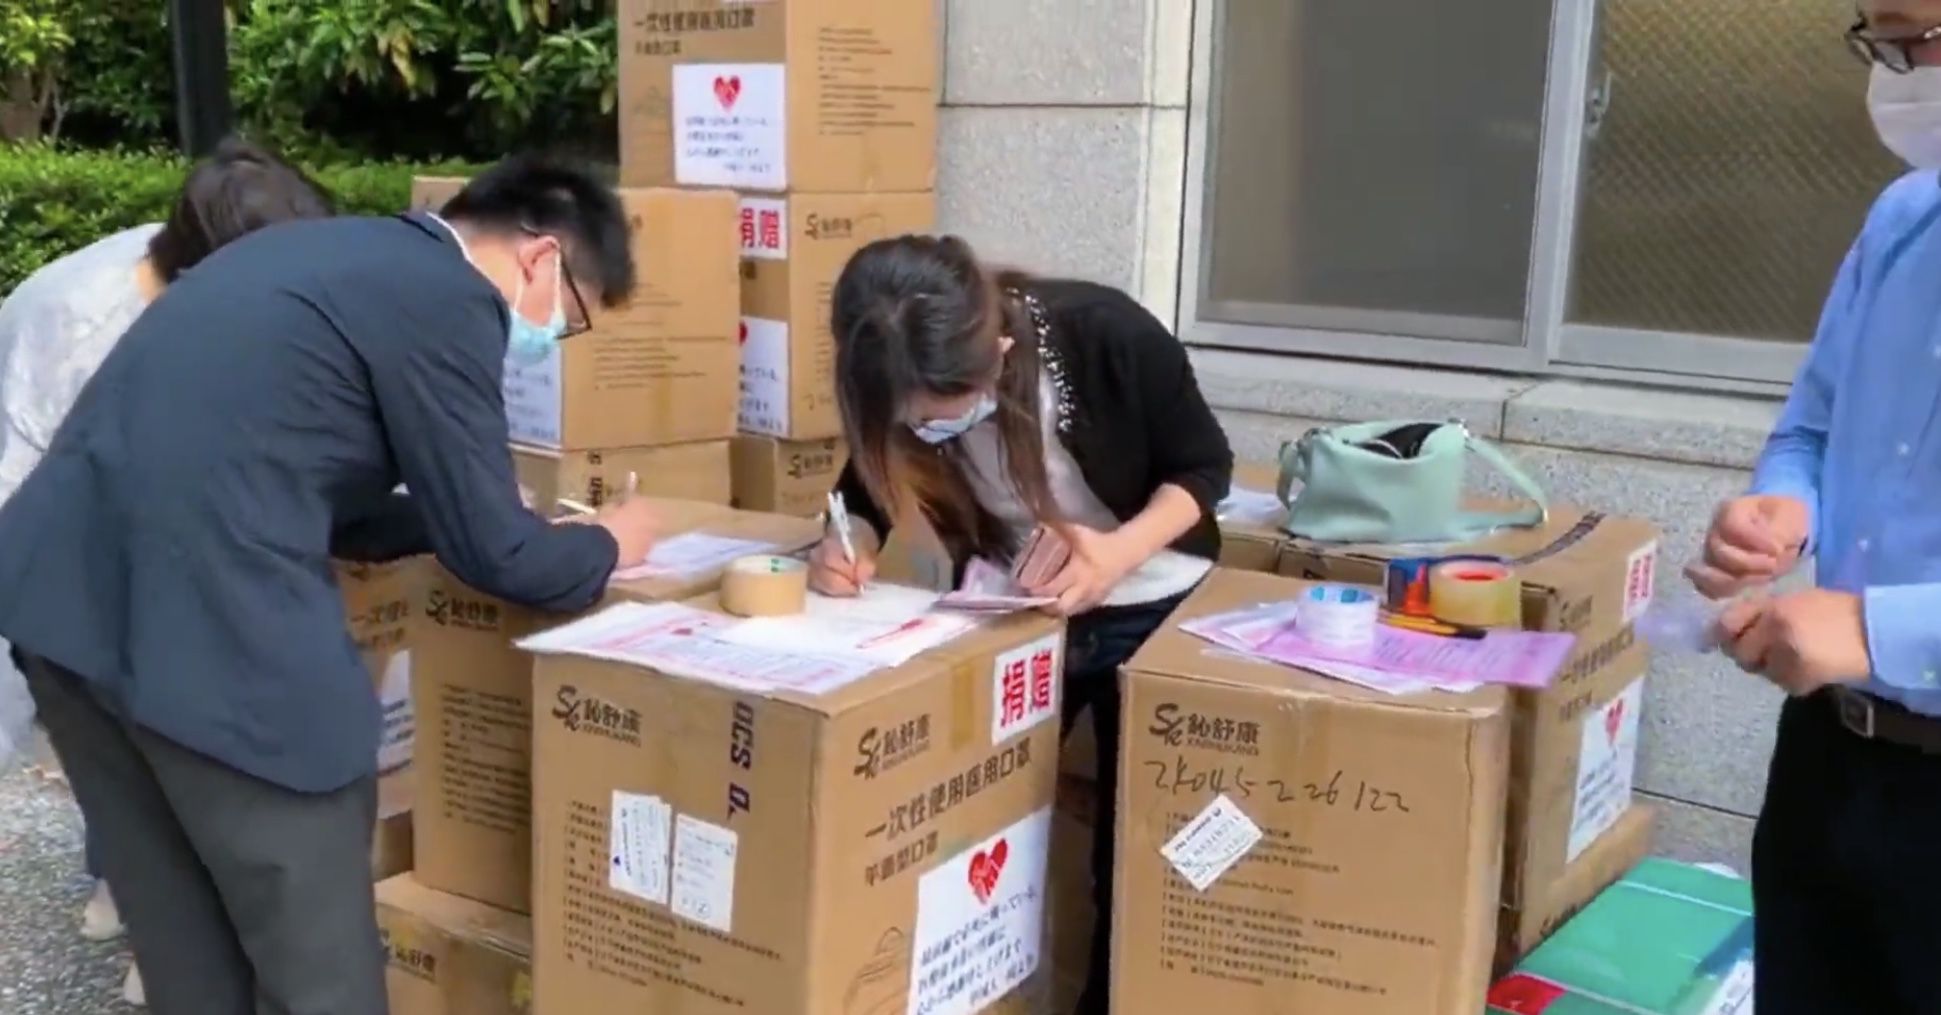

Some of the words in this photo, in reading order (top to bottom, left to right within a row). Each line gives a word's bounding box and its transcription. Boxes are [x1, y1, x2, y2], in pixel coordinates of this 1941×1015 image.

[1001, 650, 1051, 727] 捐赠
[865, 737, 1031, 841] 一次性使用医用口罩
